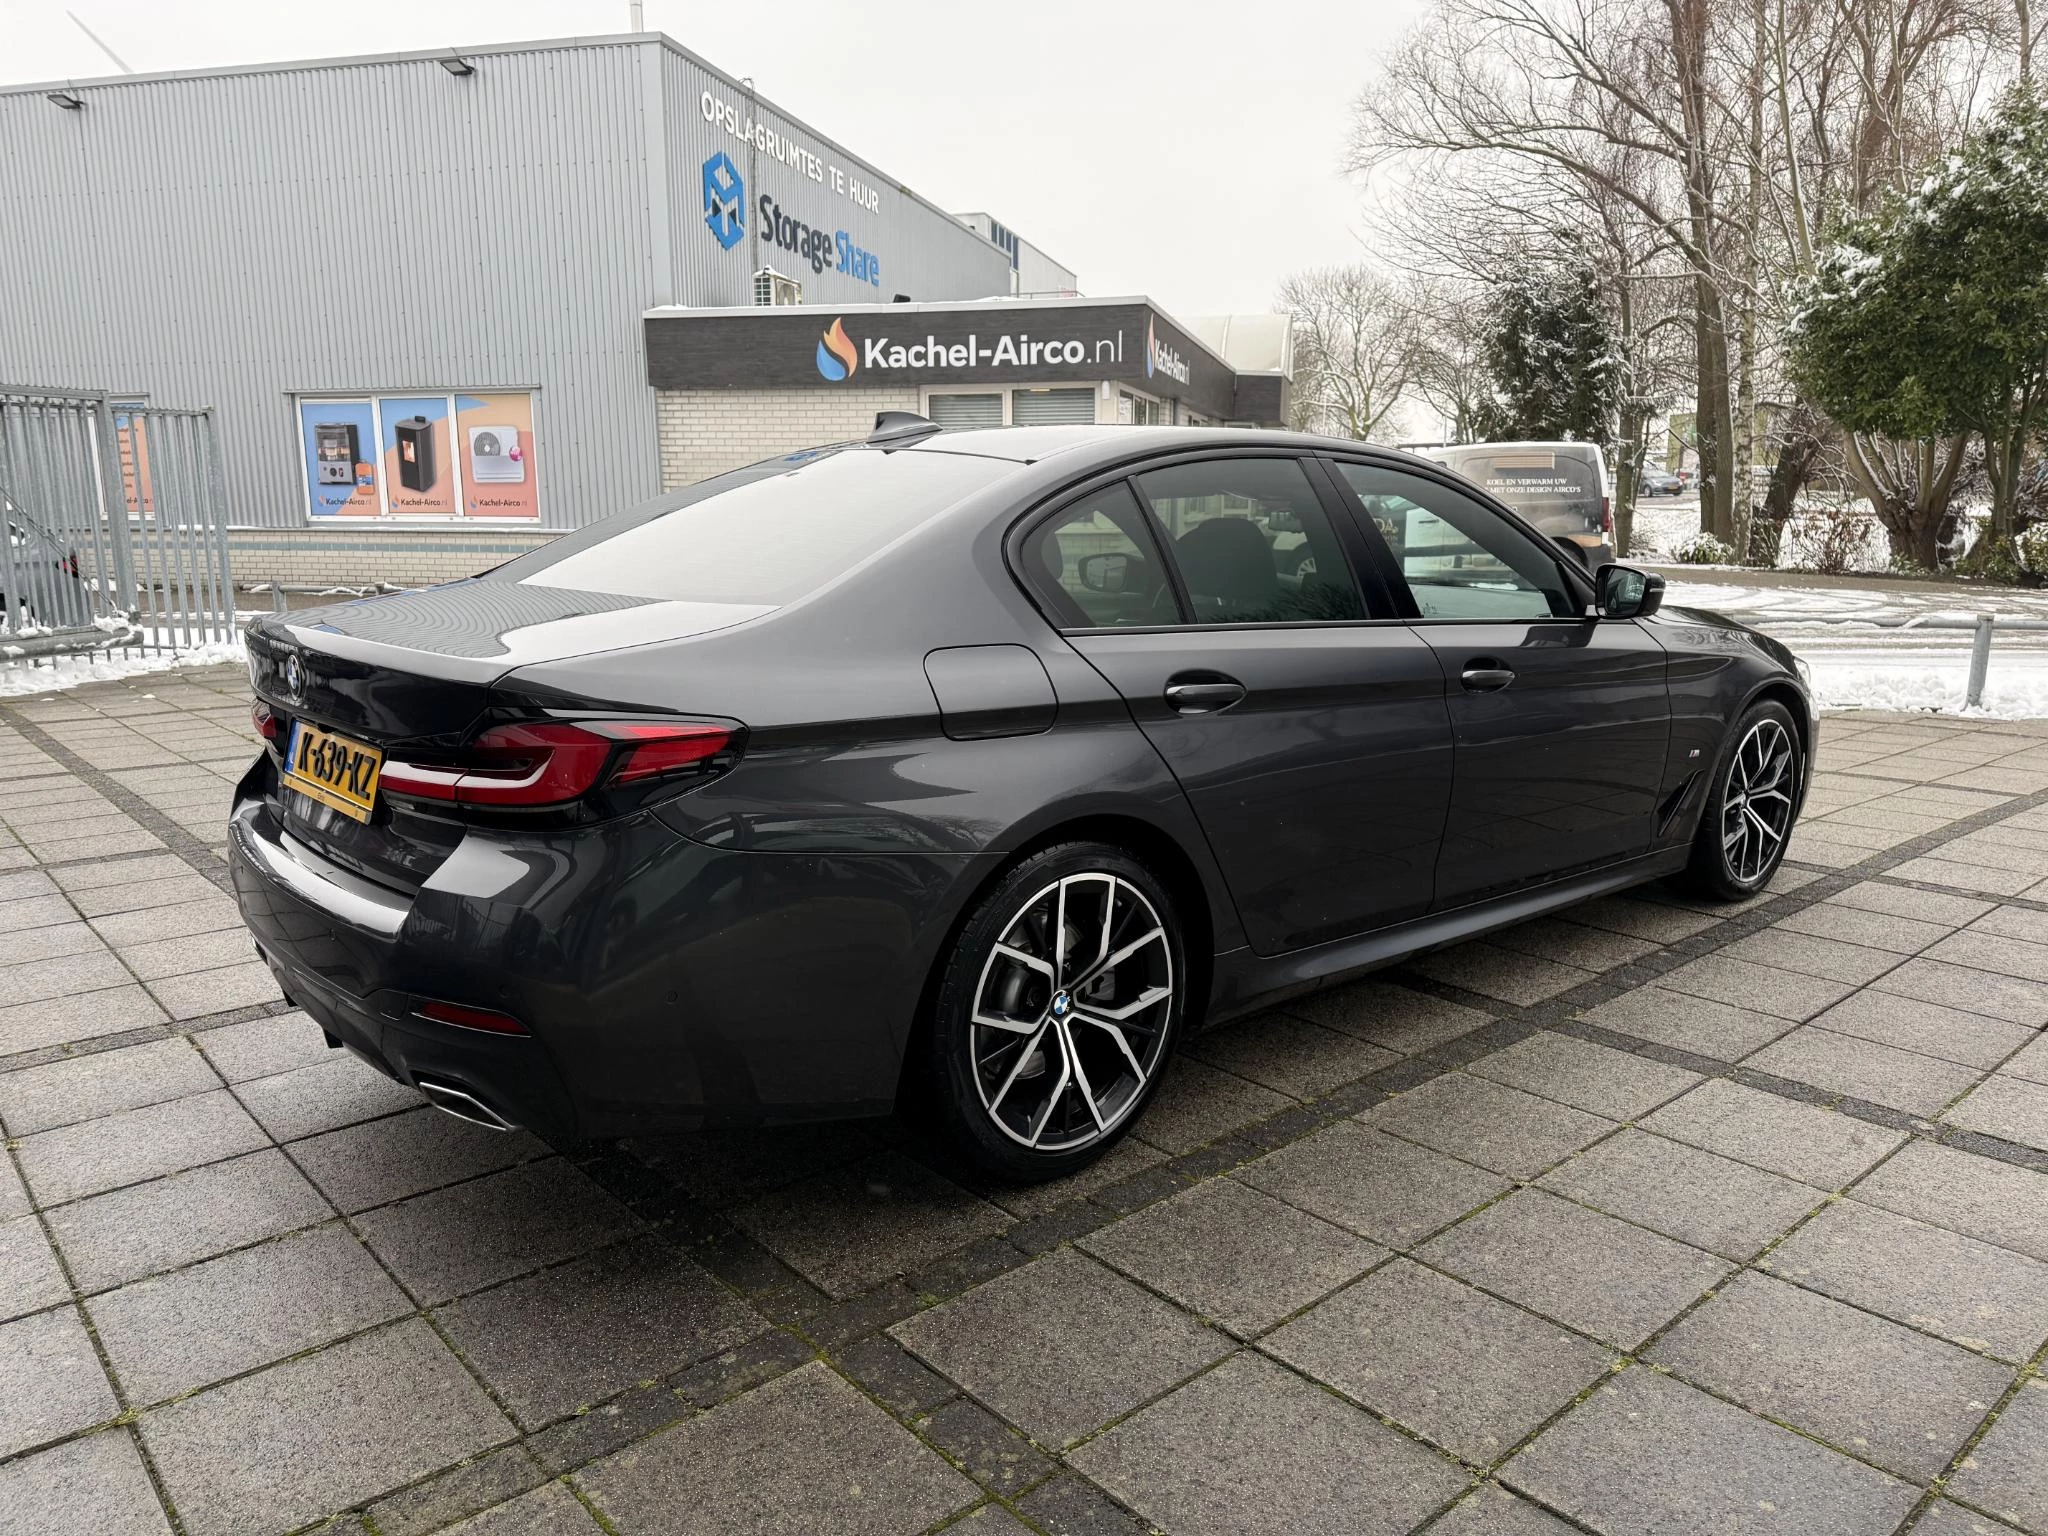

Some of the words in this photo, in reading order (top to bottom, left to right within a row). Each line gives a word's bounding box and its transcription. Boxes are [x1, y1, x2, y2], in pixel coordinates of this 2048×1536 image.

[701, 91, 823, 183] OPSLAGRUIMTES
[828, 165, 844, 195] TE
[849, 176, 879, 216] HUUR
[760, 194, 833, 274] Storage
[836, 230, 879, 287] Share
[864, 330, 1123, 369] Kachel-Airco.nl
[1506, 478, 1517, 486] EN
[1517, 478, 1554, 486] VERWARM
[298, 732, 377, 800] K-639-KZ
